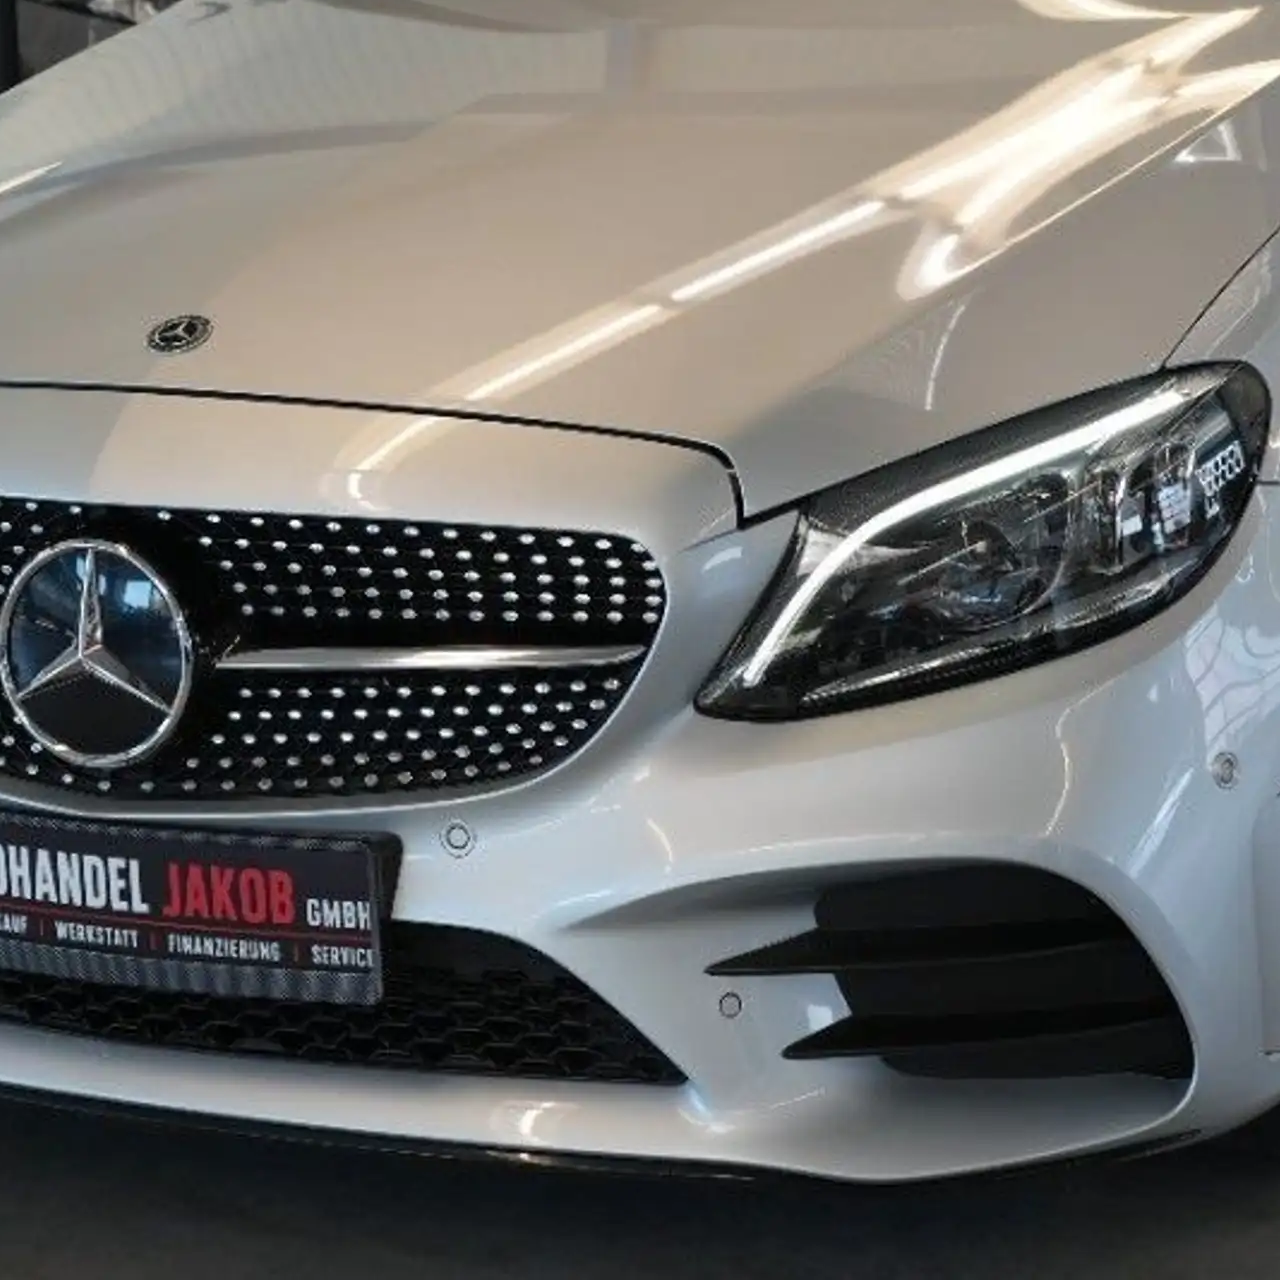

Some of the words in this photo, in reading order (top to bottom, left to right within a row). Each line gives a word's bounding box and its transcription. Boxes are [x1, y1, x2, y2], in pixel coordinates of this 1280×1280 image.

[162, 862, 296, 925] JAKOB
[306, 897, 372, 931] GMBH
[54, 921, 139, 949] WERKSTATT
[168, 933, 281, 962] FINANZIERUNG
